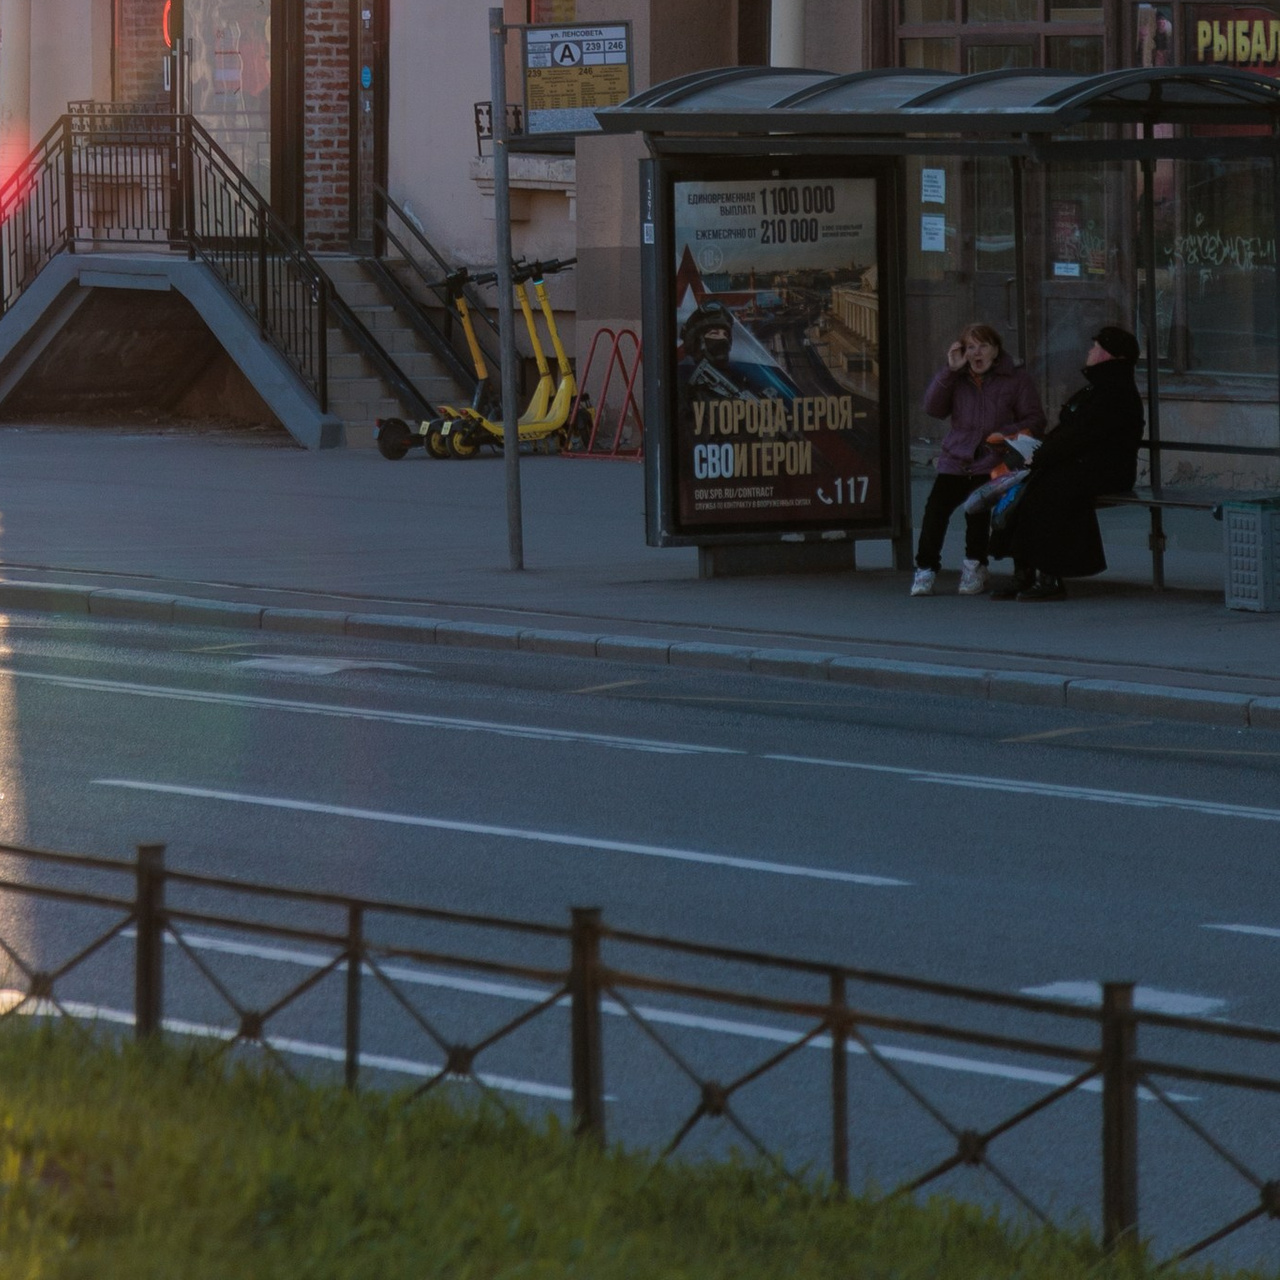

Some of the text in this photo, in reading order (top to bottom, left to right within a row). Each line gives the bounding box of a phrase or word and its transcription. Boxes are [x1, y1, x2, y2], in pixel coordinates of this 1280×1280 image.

[586, 42, 601, 51] 239
[608, 41, 623, 50] 246
[527, 69, 542, 78] 239
[578, 67, 593, 76] 246
[688, 192, 756, 206] ЕДИНОВРЕМЕННАЯ
[720, 205, 757, 216] ВЫПЛАТА
[696, 227, 757, 240] ЕЖЕМЕСЯЧНО ОТ
[760, 217, 818, 244] 210 000
[693, 400, 706, 435] У
[694, 440, 812, 480] СВОИ ГЕРОИ
[694, 486, 774, 501] GOV.SPB.RU/CONTRACT
[834, 476, 869, 505] 117
